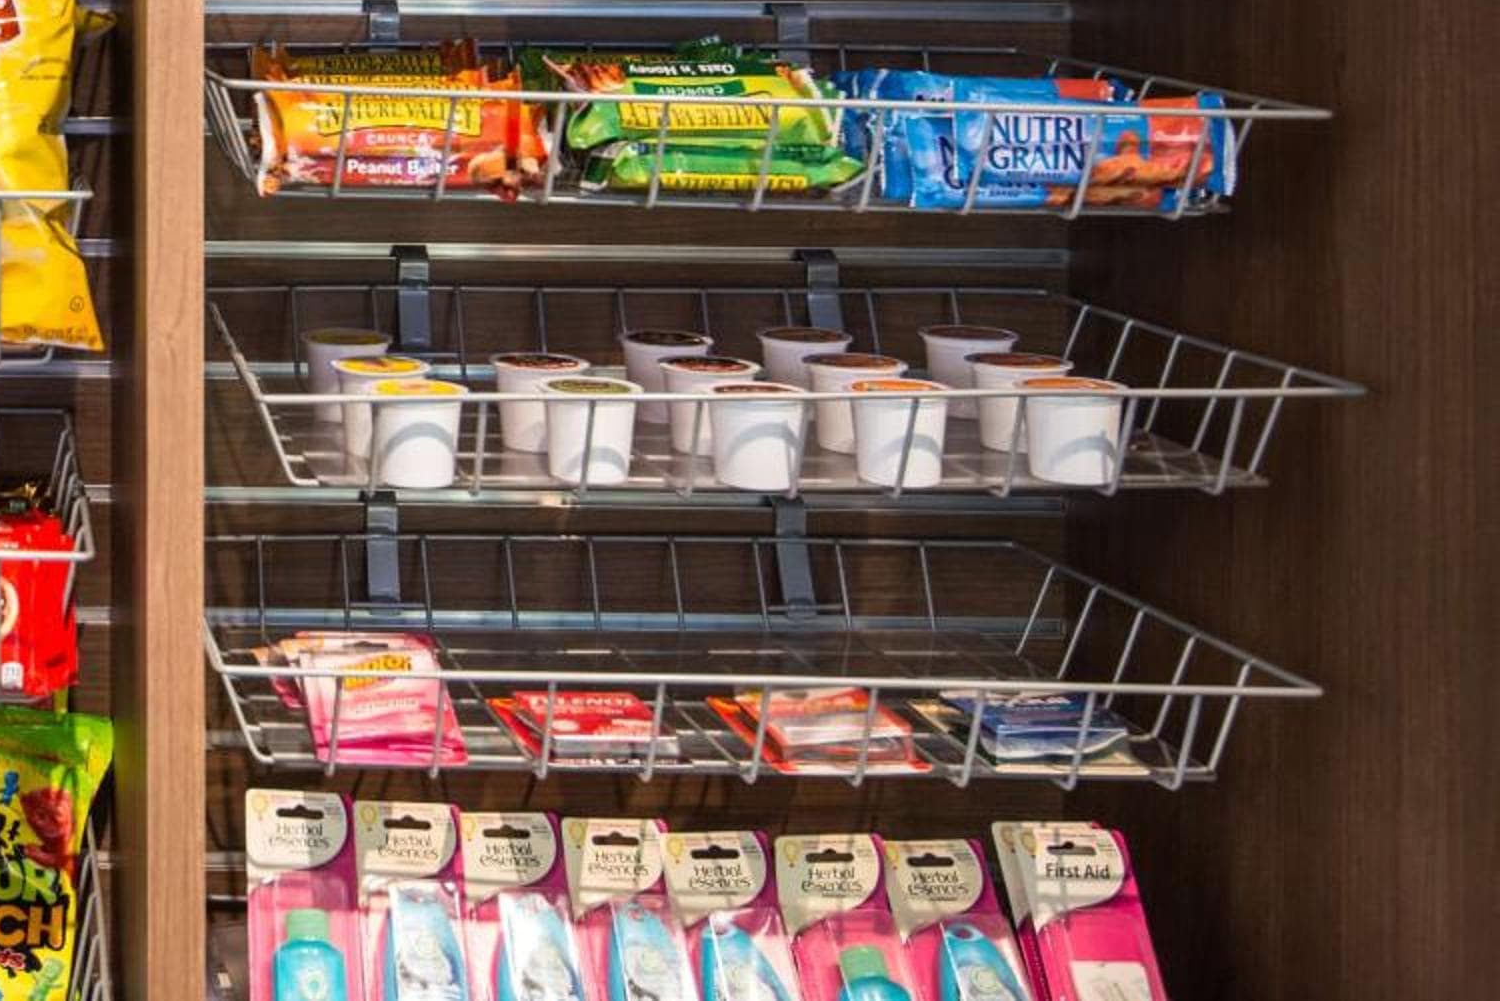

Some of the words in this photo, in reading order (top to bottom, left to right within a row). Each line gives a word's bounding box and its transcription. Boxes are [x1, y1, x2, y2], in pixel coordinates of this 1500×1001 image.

[990, 116, 1085, 144] NUTRI
[988, 146, 1087, 170] GRAIN
[346, 159, 404, 175] Peanut
[407, 159, 458, 175] Buttr
[276, 822, 324, 837] Herbal
[485, 841, 533, 856] Herbal
[1045, 863, 1082, 880] First
[1083, 863, 1111, 881] Aid
